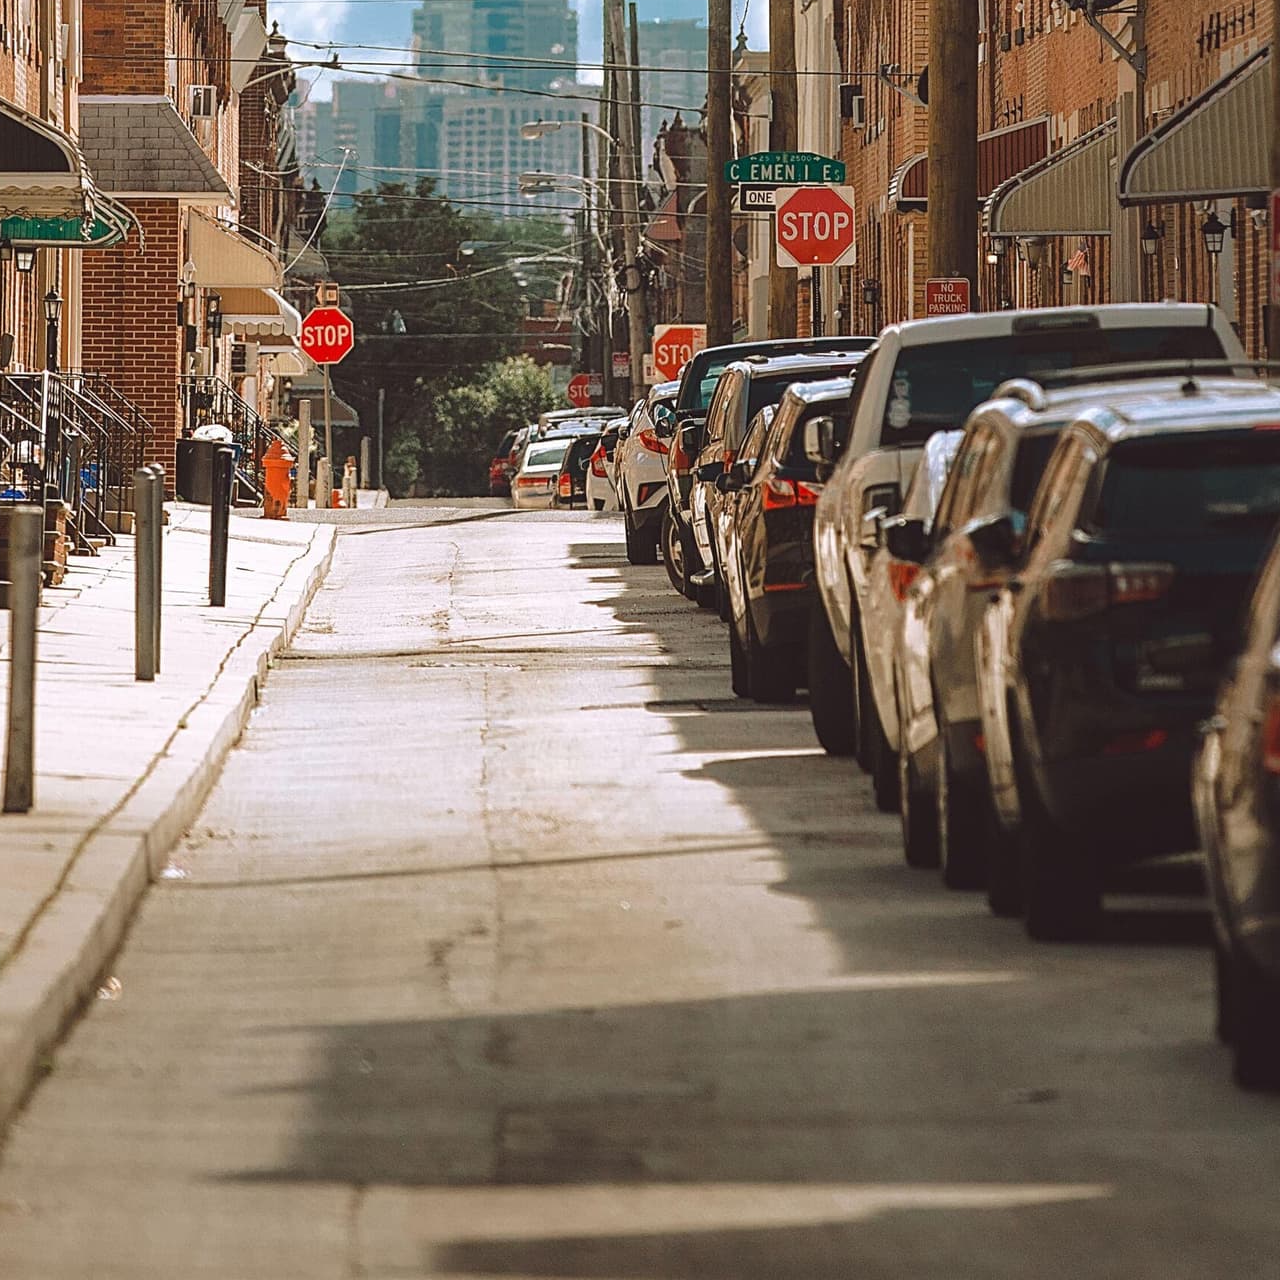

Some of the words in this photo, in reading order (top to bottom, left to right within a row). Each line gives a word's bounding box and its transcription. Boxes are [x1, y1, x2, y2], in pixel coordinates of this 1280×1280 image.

[730, 164, 831, 182] CEMENIE
[749, 192, 773, 203] ONE
[782, 211, 850, 241] STOP
[940, 283, 954, 292] NO
[933, 294, 962, 303] TRUCK
[929, 304, 967, 313] PARKING
[303, 325, 349, 347] STOP
[657, 344, 692, 365] STO
[569, 384, 591, 399] STO
